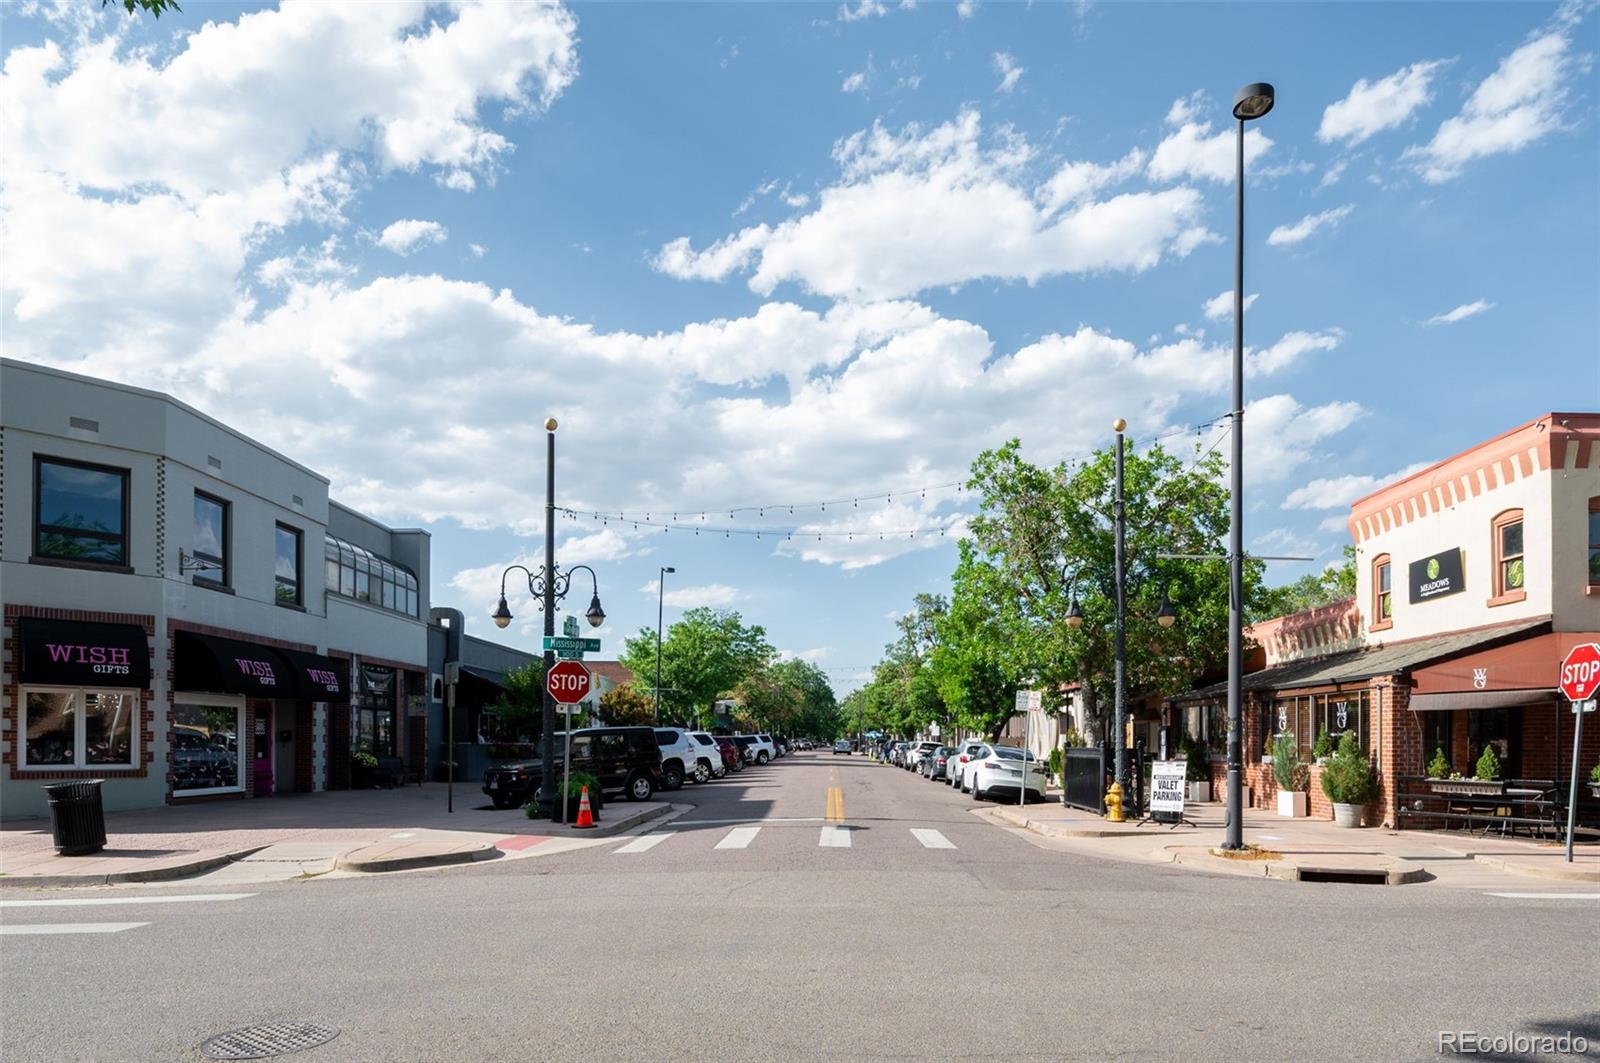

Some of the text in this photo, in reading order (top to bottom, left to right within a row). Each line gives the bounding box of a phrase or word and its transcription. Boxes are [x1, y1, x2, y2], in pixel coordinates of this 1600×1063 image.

[1420, 578, 1450, 592] MEADOWS
[550, 638, 587, 651] Mississippi
[45, 644, 131, 665] WISH
[93, 665, 129, 674] GIFTS
[234, 659, 276, 677] WISH
[1563, 660, 1600, 685] STOP
[306, 668, 339, 685] WISH
[550, 673, 588, 691] STOP
[1158, 780, 1179, 790] VALET
[1153, 791, 1182, 801] PARKING
